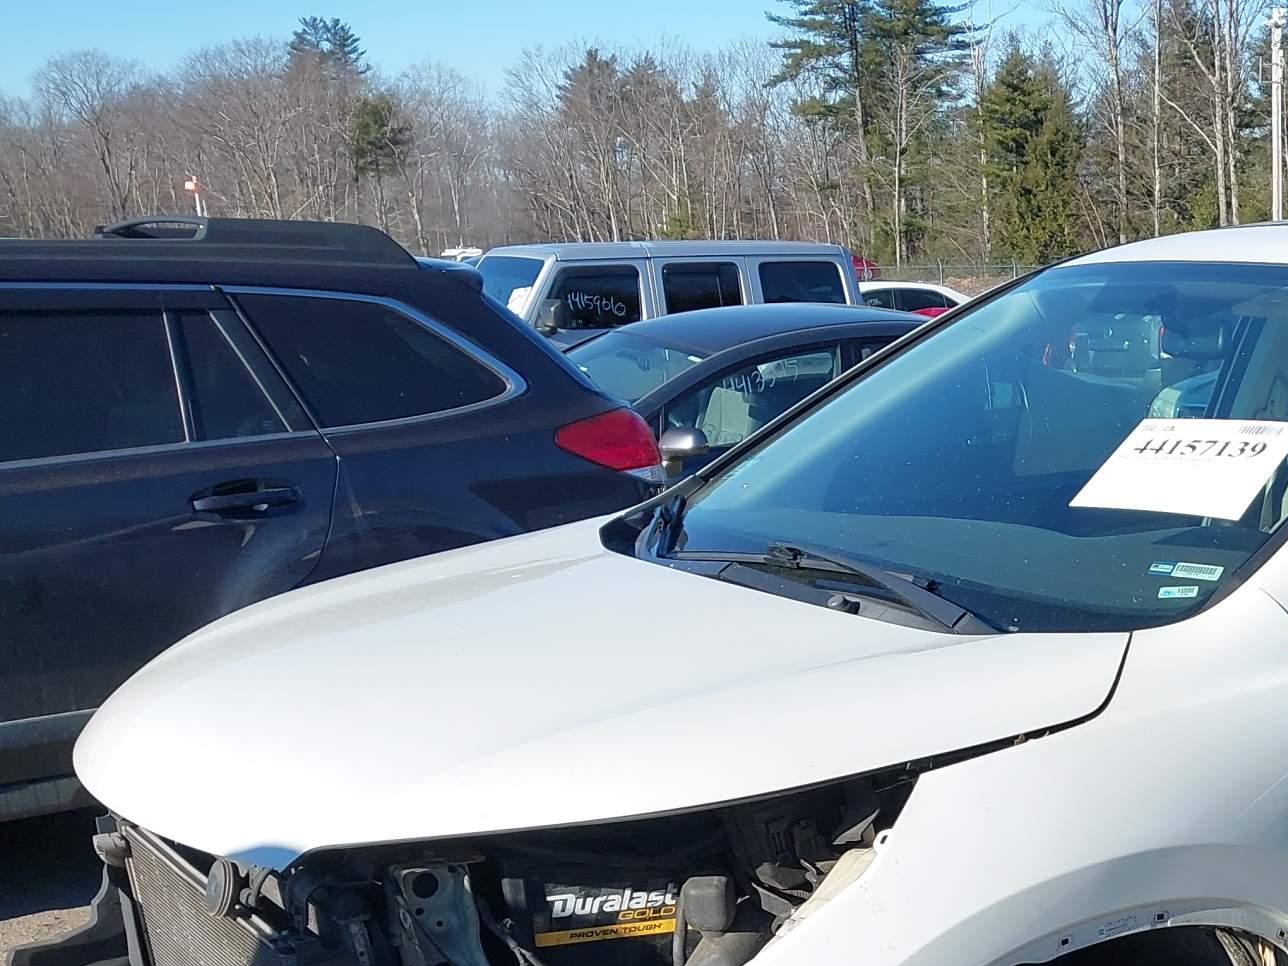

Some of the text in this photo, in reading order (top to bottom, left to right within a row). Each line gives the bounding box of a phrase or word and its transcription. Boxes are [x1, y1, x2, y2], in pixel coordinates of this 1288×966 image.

[1134, 439, 1268, 458] 44157139
[546, 884, 677, 918] Duralast
[619, 906, 676, 920] GOLD
[570, 923, 661, 939] PROVEN TOUGH
